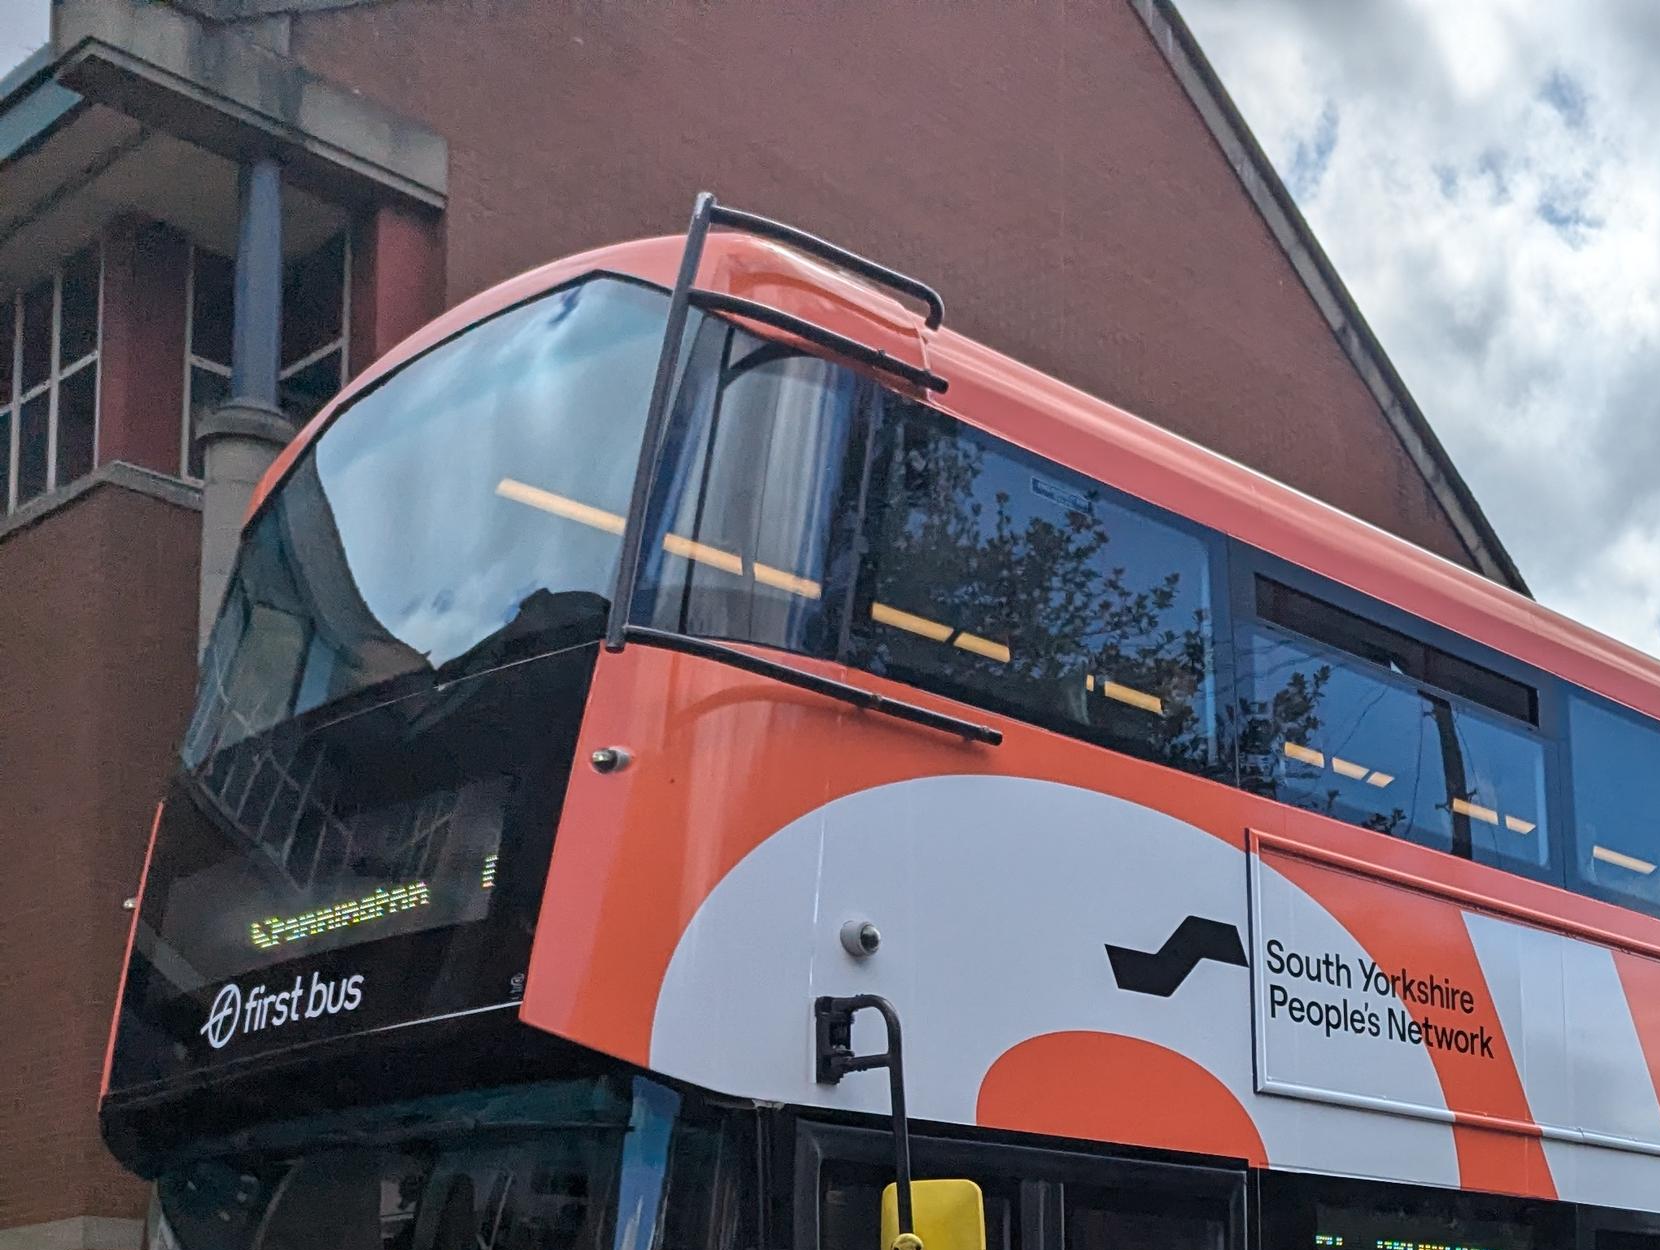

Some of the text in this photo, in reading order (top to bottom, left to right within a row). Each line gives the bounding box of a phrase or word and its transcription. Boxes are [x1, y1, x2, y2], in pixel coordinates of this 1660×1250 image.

[243, 971, 364, 1034] first bus
[1266, 939, 1475, 1015] South Yorkshire
[1269, 984, 1494, 1060] People's Network
